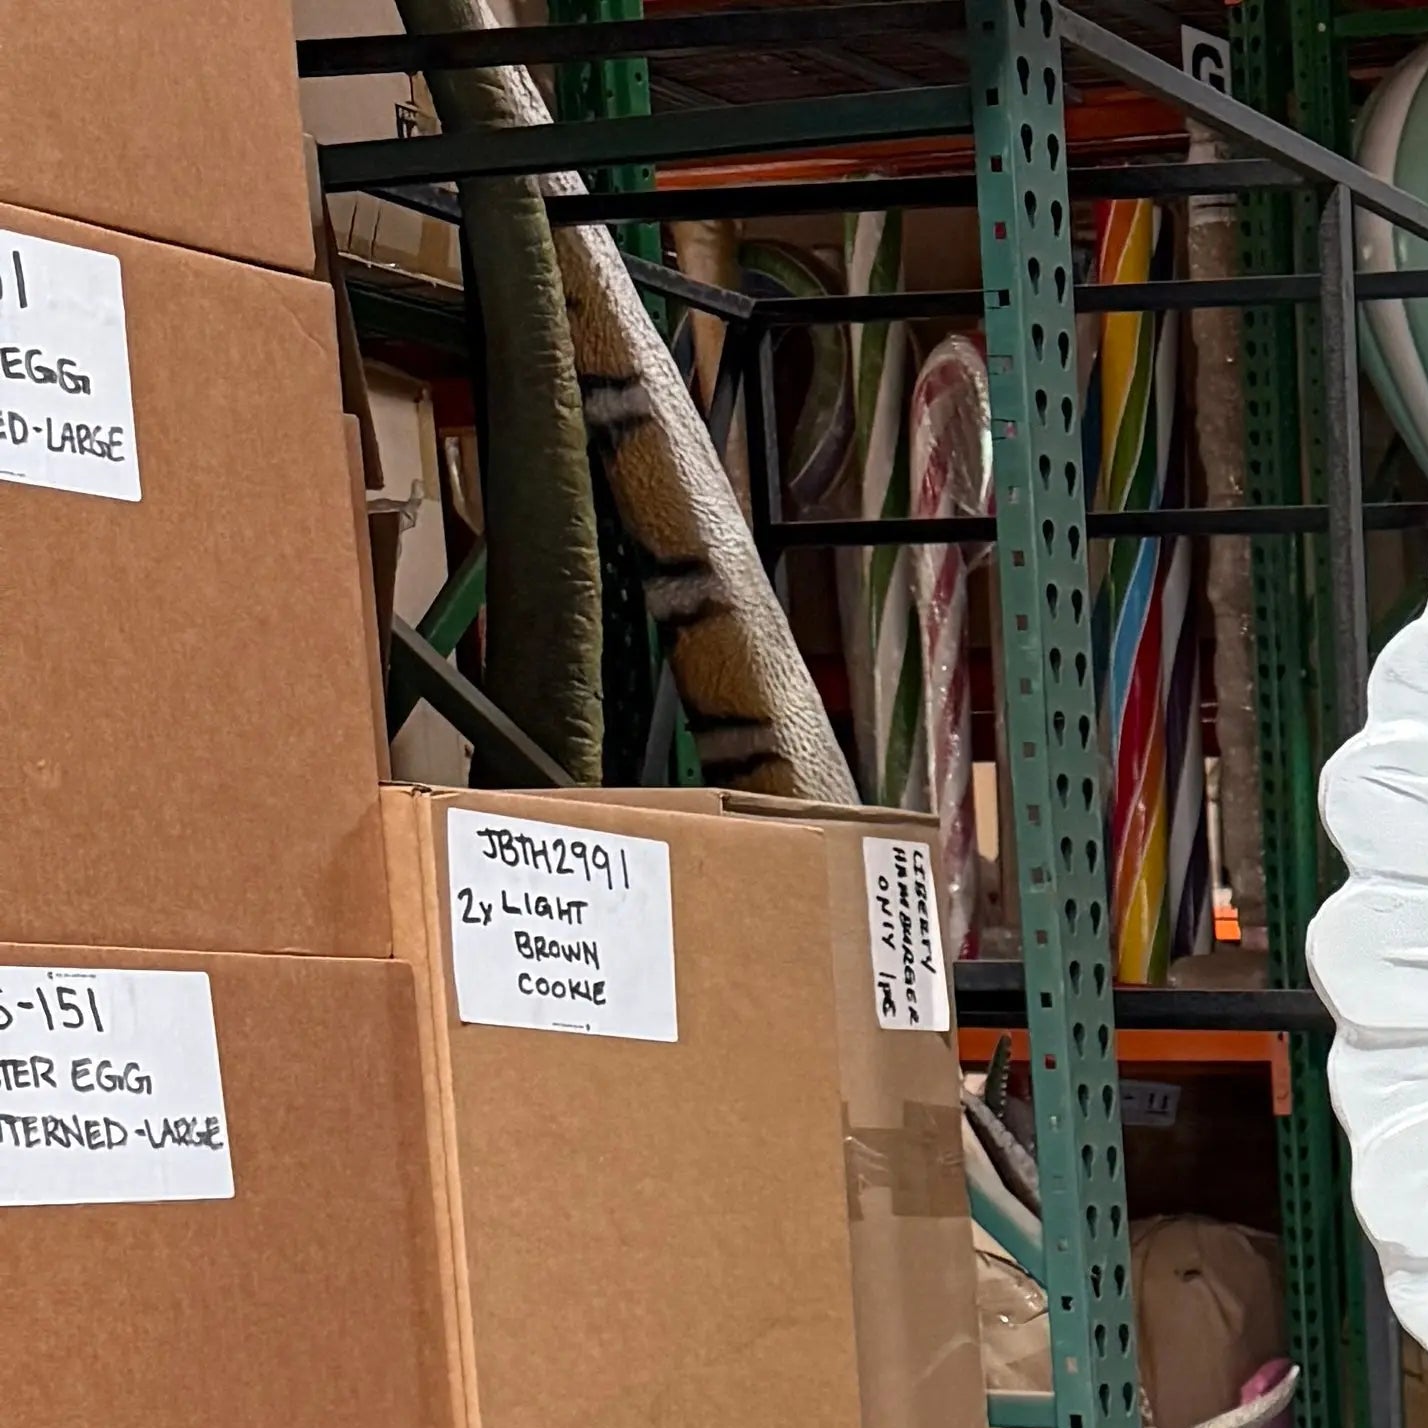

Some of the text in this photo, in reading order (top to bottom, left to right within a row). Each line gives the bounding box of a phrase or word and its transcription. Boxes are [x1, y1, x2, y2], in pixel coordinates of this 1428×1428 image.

[501, 890, 588, 925] LIGHT
[514, 931, 600, 970] BROWN
[518, 973, 607, 1006] COOKIE
[71, 1057, 153, 1094] EGG
